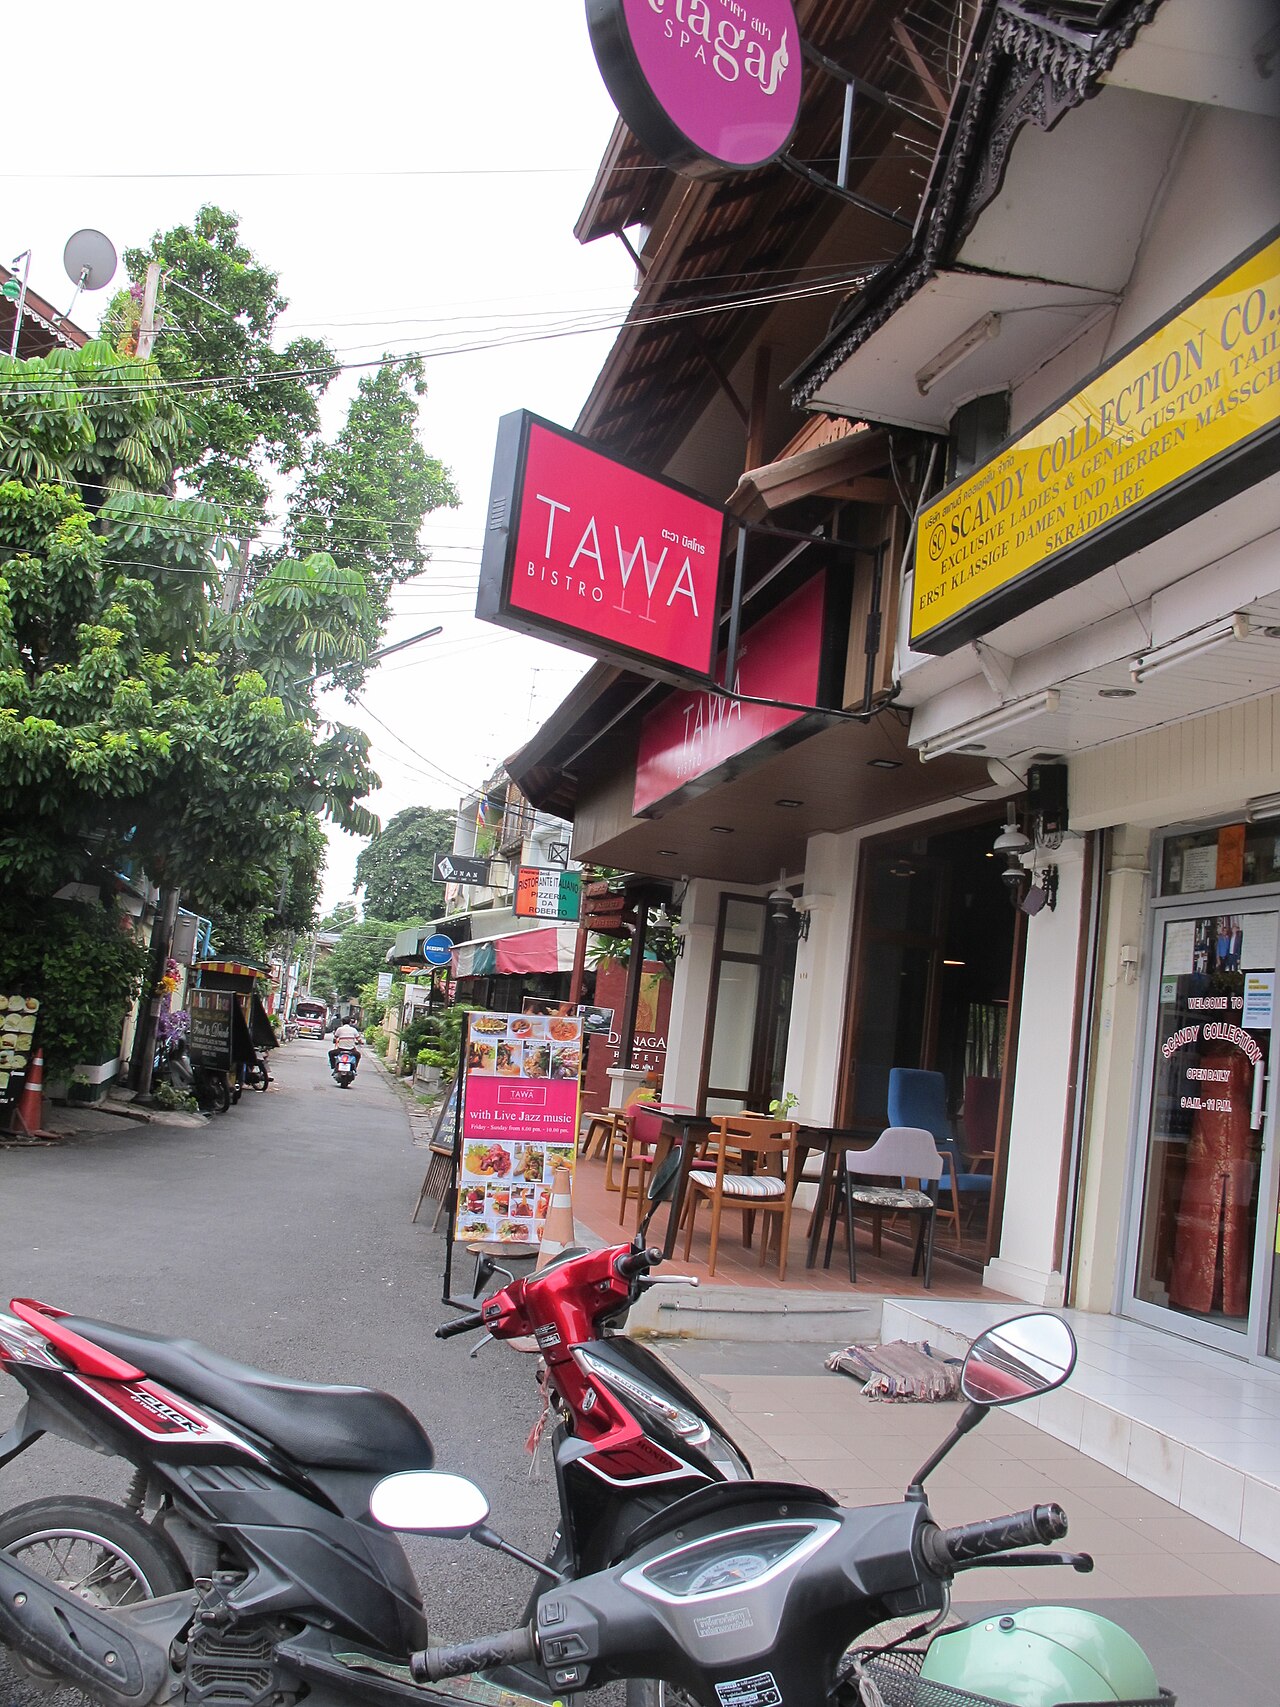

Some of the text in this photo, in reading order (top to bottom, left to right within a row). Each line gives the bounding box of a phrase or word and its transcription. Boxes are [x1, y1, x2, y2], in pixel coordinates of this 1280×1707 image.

[664, 18, 706, 65] SPA
[950, 462, 1029, 545] SCANDY
[1038, 328, 1207, 483] COLLECTION
[941, 520, 1005, 575] EXCLUSIVE
[1009, 482, 1060, 528] LADIES
[1064, 471, 1075, 491] &
[1081, 430, 1134, 480] GENTS
[1140, 368, 1222, 437] CUSTOM
[919, 581, 947, 610] ERST
[950, 540, 1009, 591] KLASSIGE
[1015, 503, 1066, 549] DAMEN
[1073, 477, 1106, 511] UND
[1113, 422, 1188, 487] HERREN
[1045, 479, 1145, 555] SKRÄDDARE
[661, 528, 679, 544] ตะวา
[536, 494, 699, 617] TAWA
[527, 561, 603, 602] BISTRO
[683, 668, 741, 756] TAWA
[519, 877, 553, 890] RISTORANTE
[531, 891, 567, 900] PIZZERIA
[529, 907, 568, 916] ROBERTO
[1188, 996, 1243, 1010] WELCOME TO
[1161, 1022, 1262, 1065] SCANDY COLLECTION
[613, 1050, 660, 1063] HTEL
[1186, 1067, 1231, 1082] OPEN DAILY
[511, 1090, 534, 1098] TAWA
[1206, 1098, 1215, 1110] 11
[470, 1109, 572, 1123] with Live Jazz music
